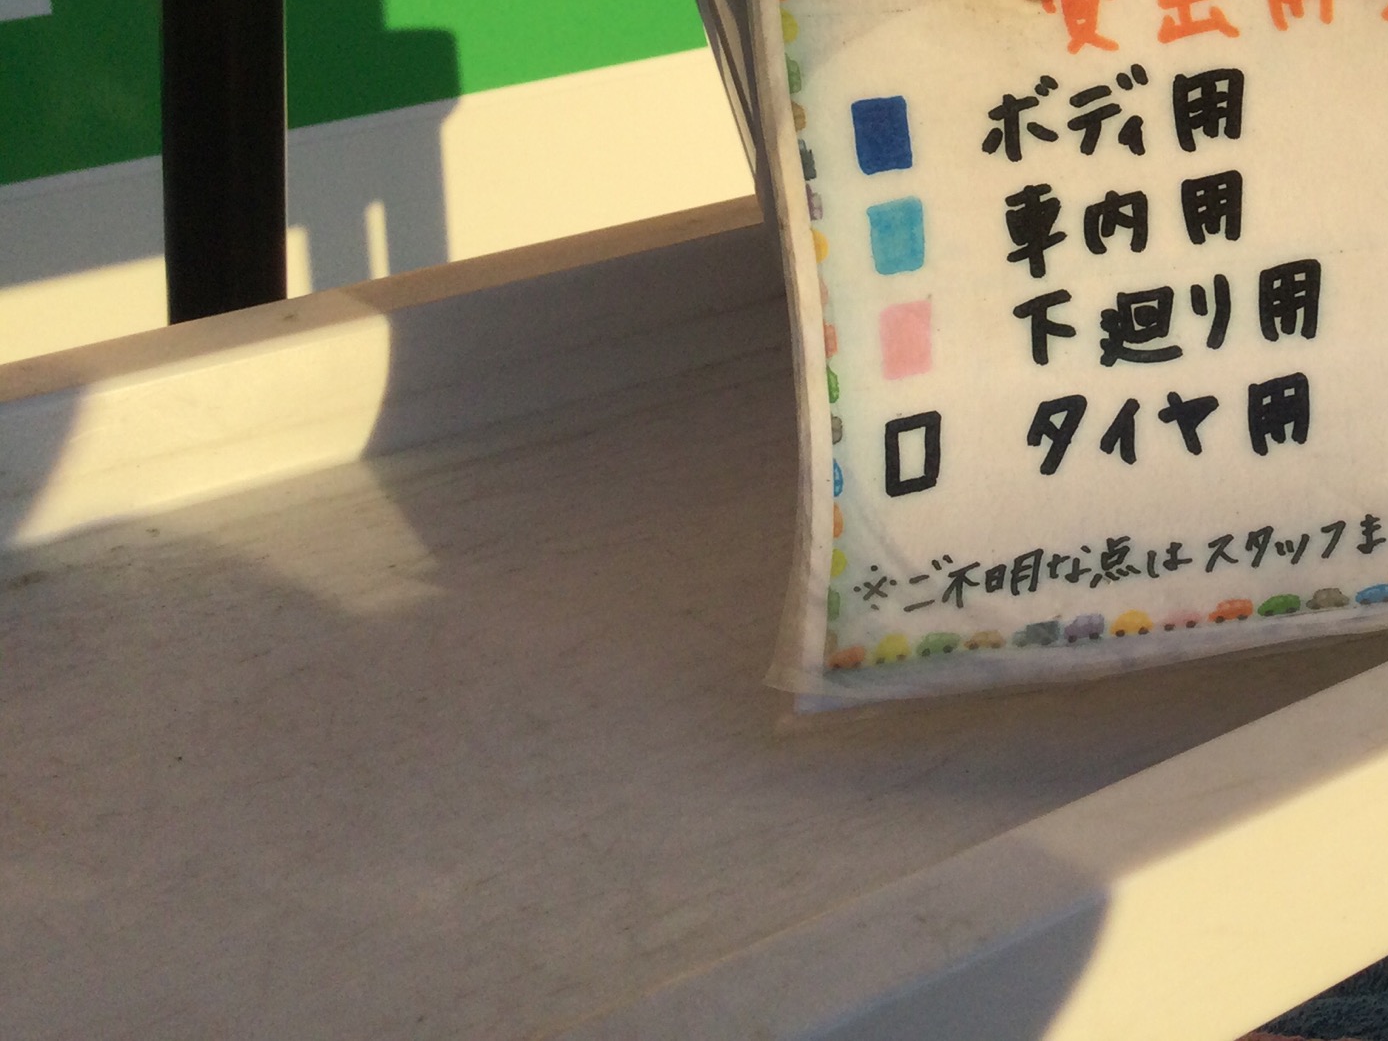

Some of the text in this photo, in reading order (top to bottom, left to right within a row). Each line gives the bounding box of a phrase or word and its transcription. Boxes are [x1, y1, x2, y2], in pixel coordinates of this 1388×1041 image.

[982, 63, 1245, 162] ボディ用
[1005, 169, 1243, 279] 車内用
[1013, 258, 1322, 366] 下廻り用
[1026, 371, 1311, 476] タイヤ用
